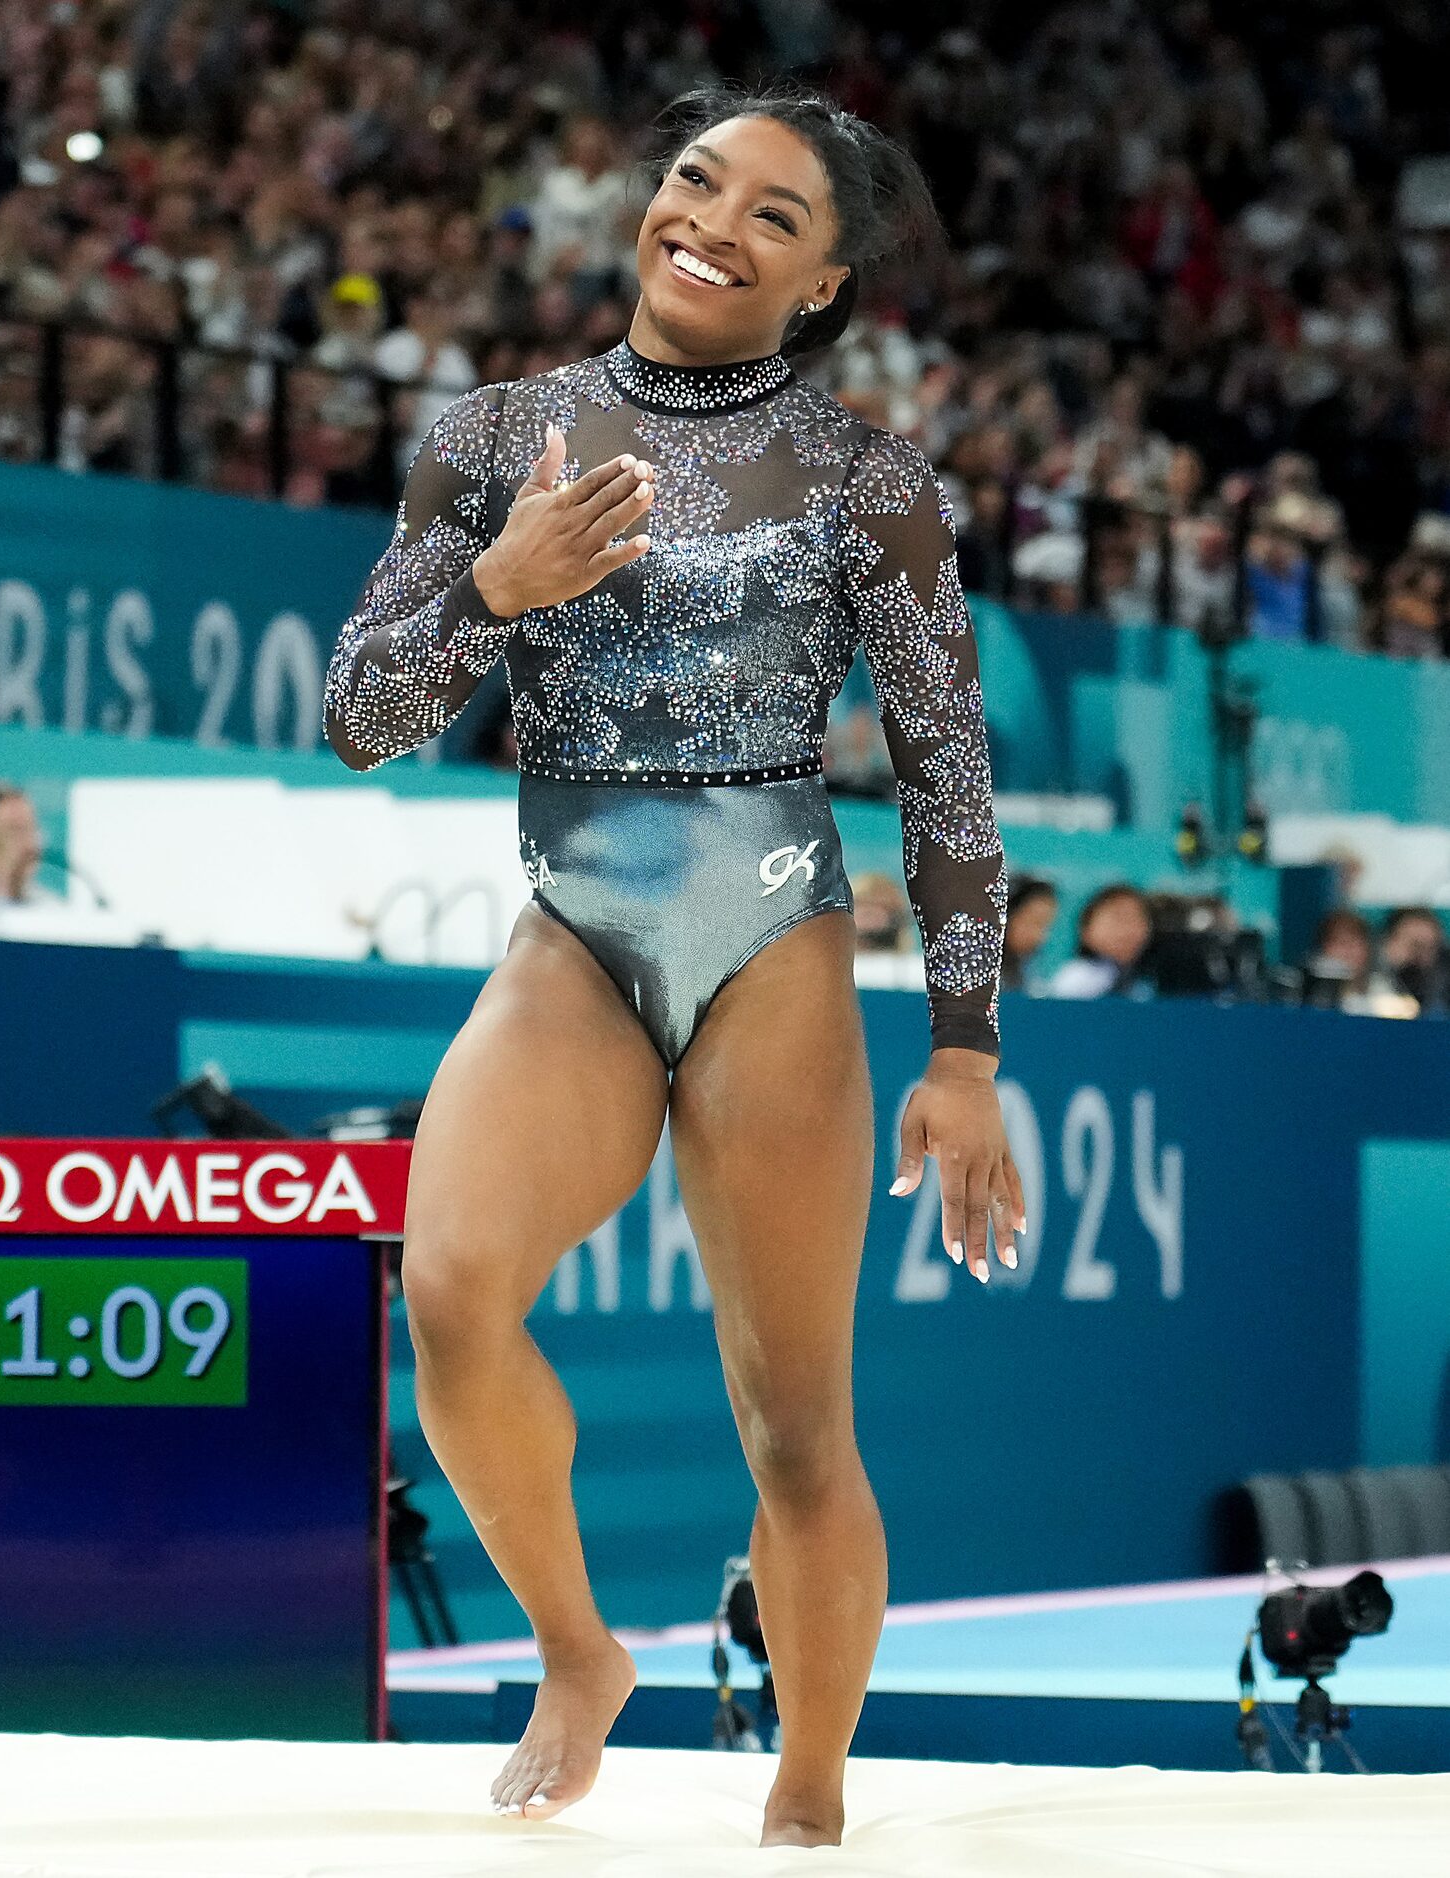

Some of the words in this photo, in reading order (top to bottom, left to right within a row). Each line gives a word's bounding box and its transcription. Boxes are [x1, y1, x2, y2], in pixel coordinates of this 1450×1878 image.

[521, 854, 558, 889] SA
[46, 1152, 378, 1223] OMEGA
[0, 1286, 230, 1378] 1:09
